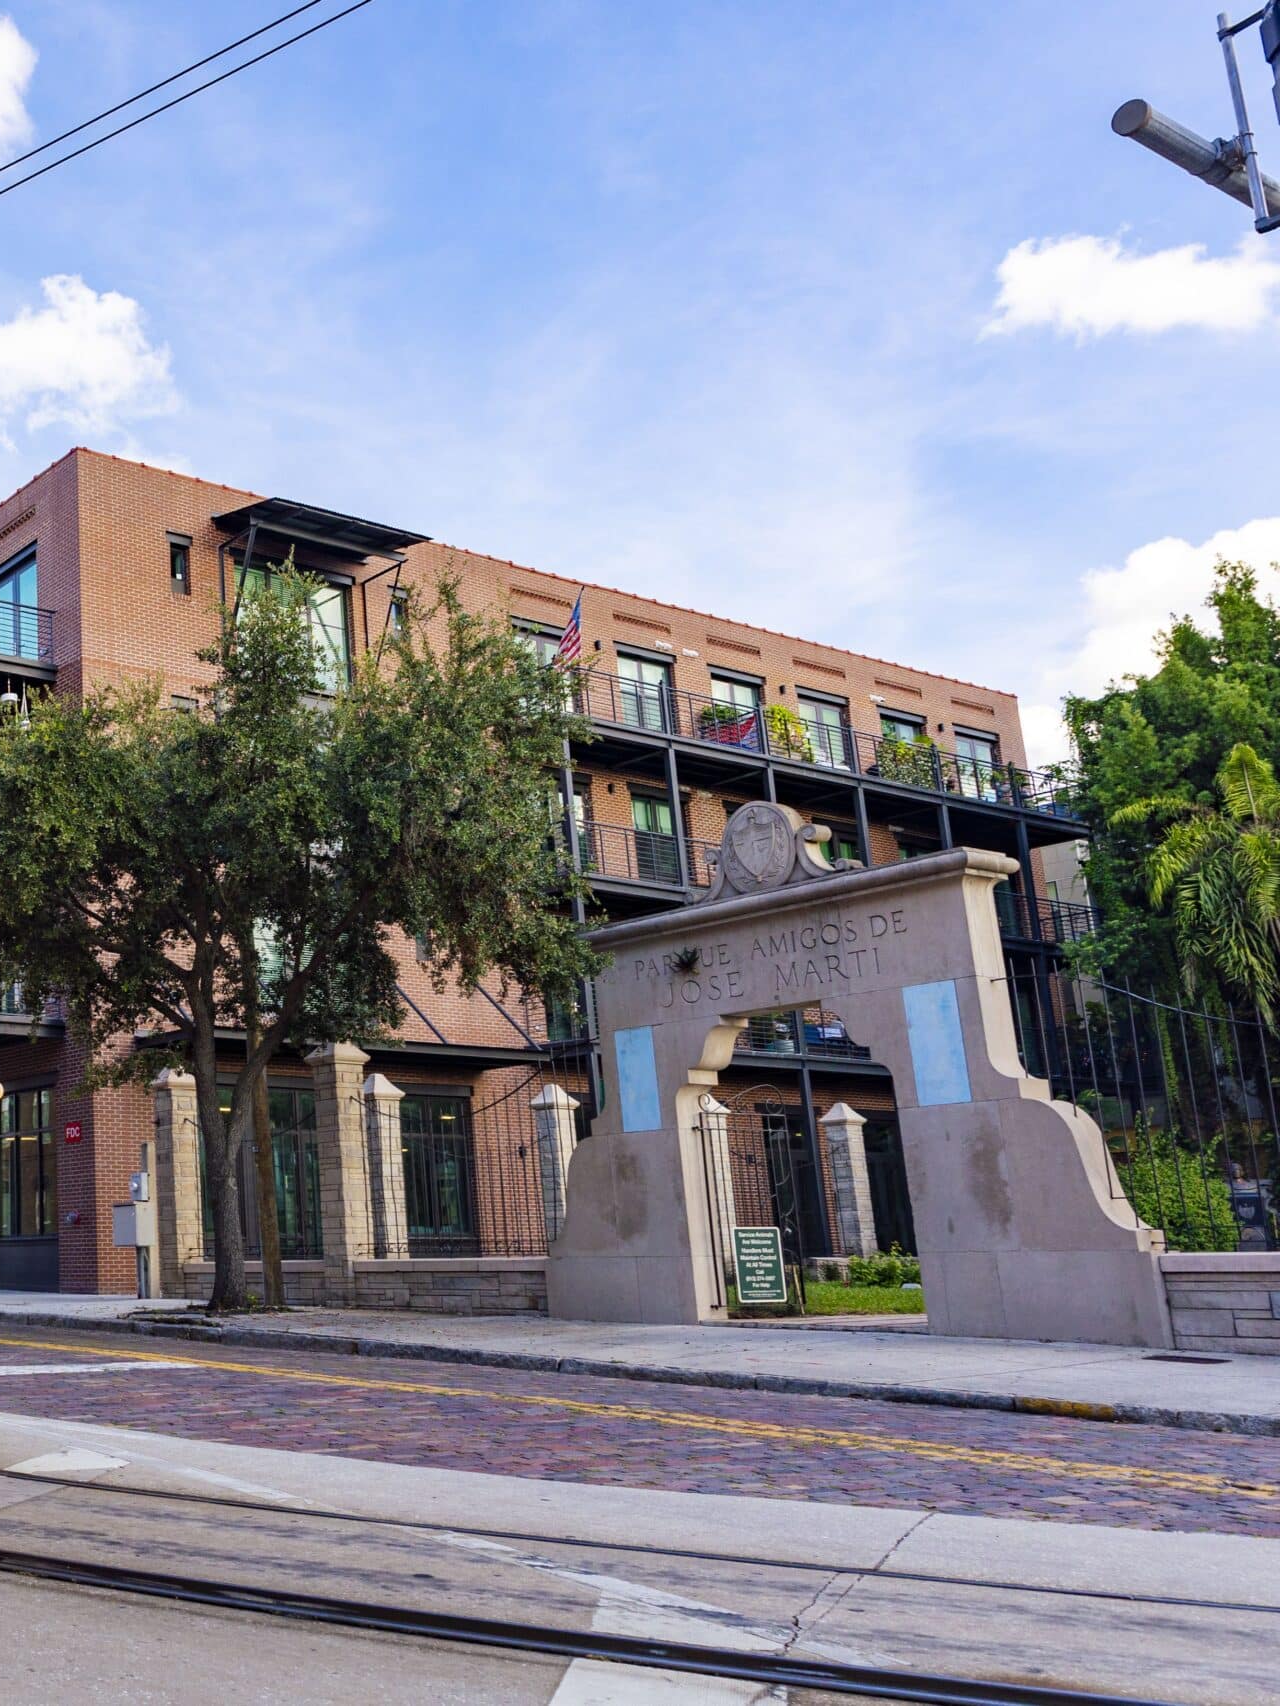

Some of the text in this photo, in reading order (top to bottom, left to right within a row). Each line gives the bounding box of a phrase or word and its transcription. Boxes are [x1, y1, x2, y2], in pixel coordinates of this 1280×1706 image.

[634, 910, 909, 981] PARUE AMIGOS DE
[662, 947, 882, 1008] JOSE MARTI
[66, 1126, 81, 1138] FDC
